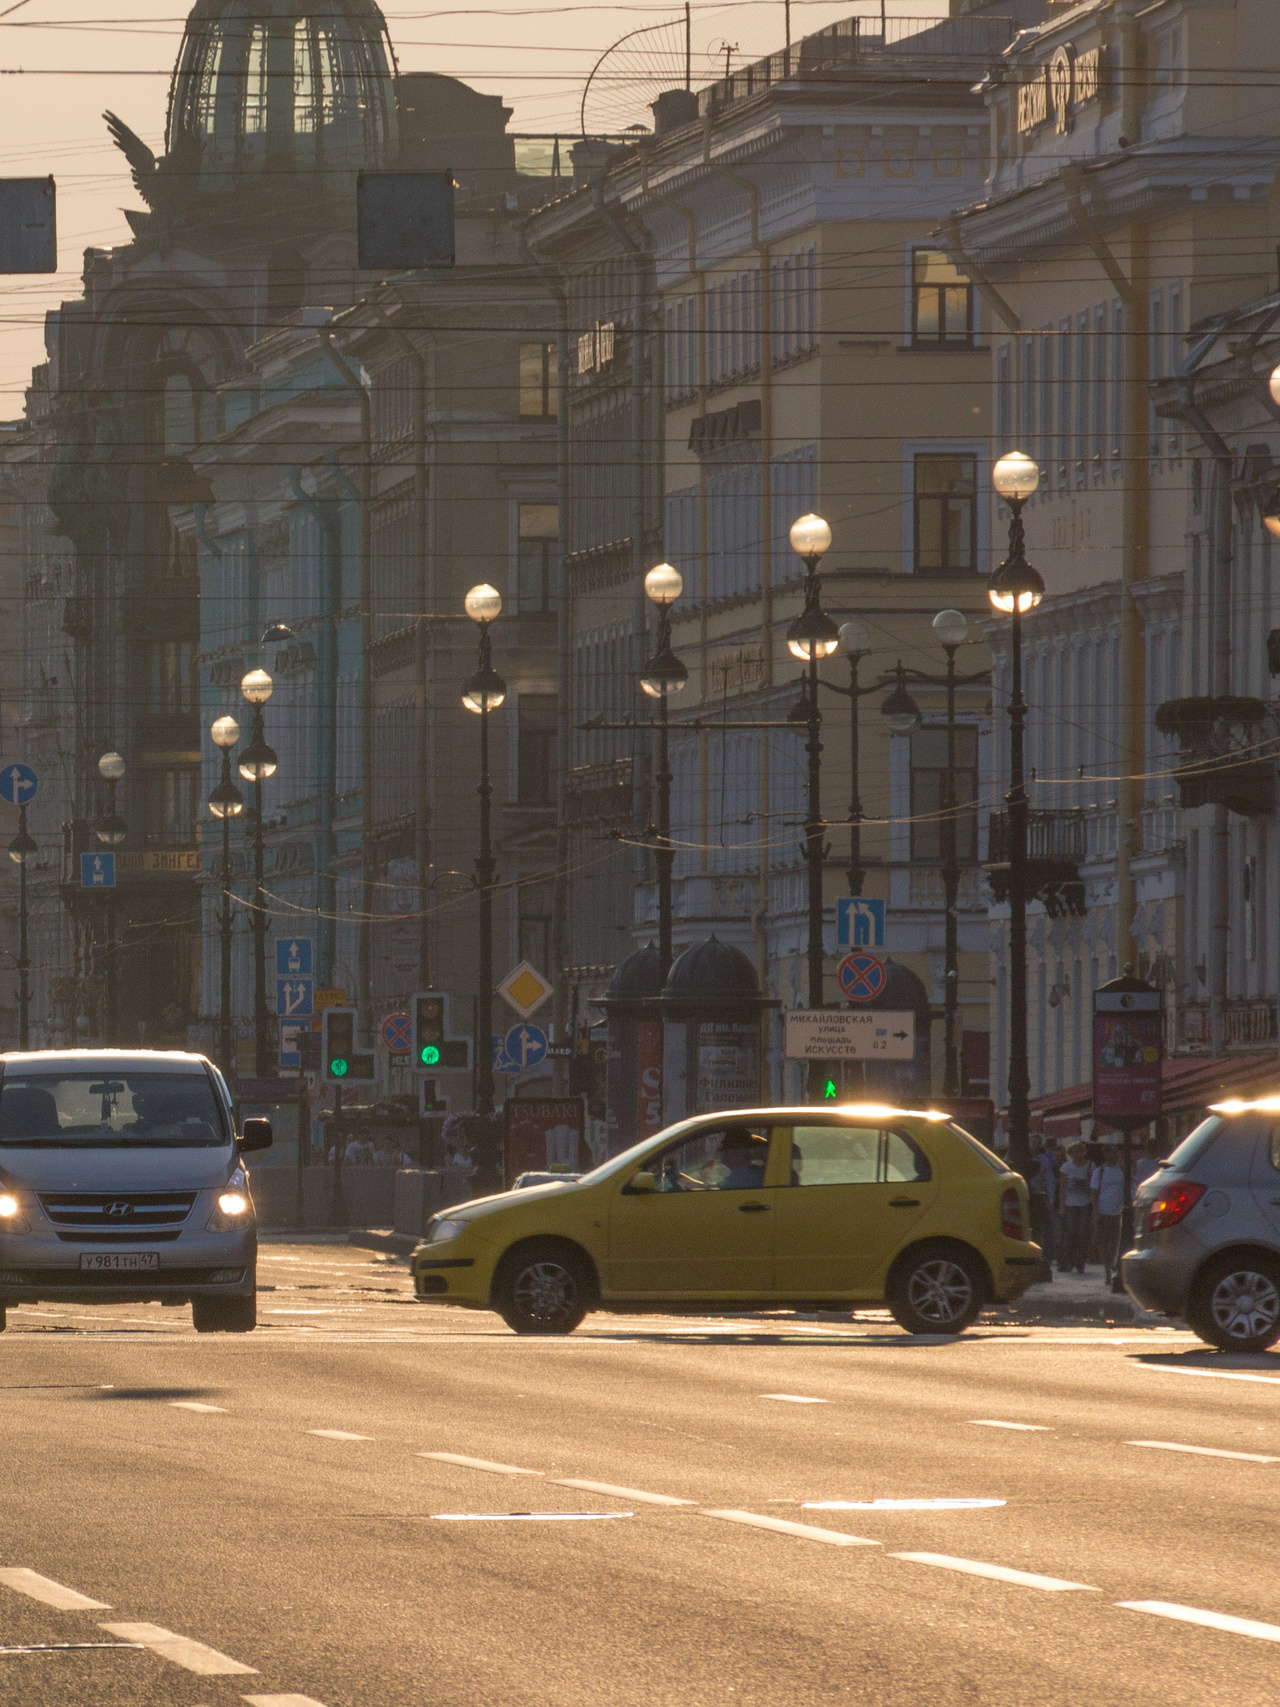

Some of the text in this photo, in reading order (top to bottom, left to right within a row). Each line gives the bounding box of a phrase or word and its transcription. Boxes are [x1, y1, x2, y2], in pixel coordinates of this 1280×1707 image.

[790, 1013, 873, 1024] МИХАЙЛОВСКАЯ
[817, 1025, 846, 1034] улица
[810, 1036, 852, 1044] площадь
[804, 1045, 856, 1054] ИСКУССТВ
[510, 1104, 578, 1118] TSUBAKI
